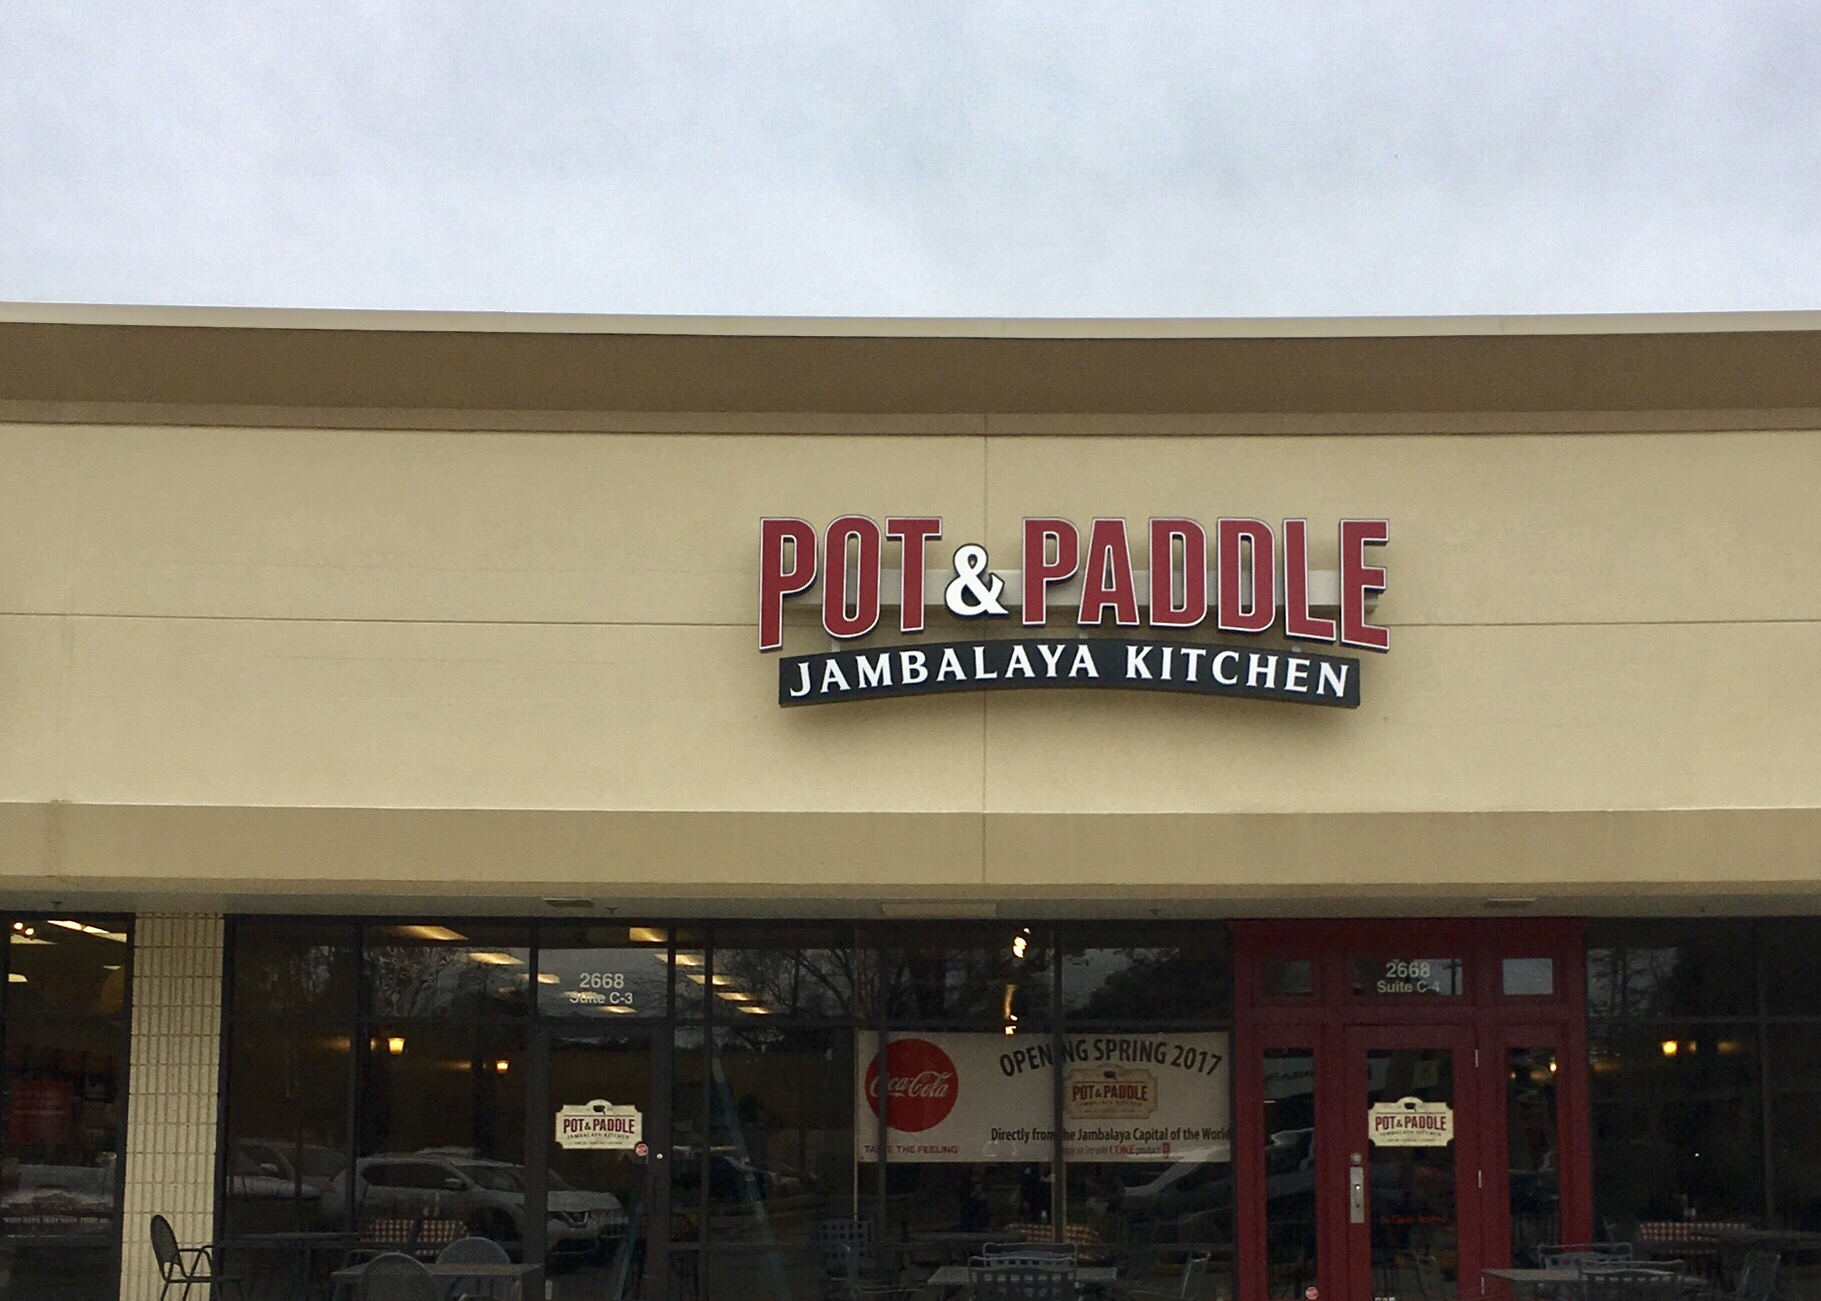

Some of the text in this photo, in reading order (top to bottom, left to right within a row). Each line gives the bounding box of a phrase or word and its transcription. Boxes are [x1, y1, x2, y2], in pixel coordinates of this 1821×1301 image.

[761, 515, 1390, 652] POT & PADDLE
[789, 644, 1350, 698] JAMBALAYA KITCHEN
[1385, 962, 1431, 978] 2668
[579, 972, 625, 989] 2668
[1376, 980, 1413, 993] Suite
[609, 991, 634, 1004] C-3
[1000, 1038, 1223, 1077] OPENNG SPRING 2017
[869, 1070, 954, 1098] Cca-Cola
[1072, 1085, 1095, 1102] POT
[1103, 1085, 1148, 1102] PADDLE
[563, 1118, 585, 1134] POT
[593, 1118, 635, 1134] PADDLE
[1375, 1115, 1396, 1131] POT
[1404, 1115, 1447, 1131] PADDLE
[991, 1127, 1030, 1143] Directly
[1032, 1127, 1055, 1141] from
[1059, 1127, 1076, 1141] he
[1077, 1128, 1131, 1143] Jambalaya
[1132, 1127, 1169, 1143] Capital
[1170, 1127, 1181, 1141] of
[1182, 1127, 1200, 1141] the
[896, 1145, 915, 1153] THE
